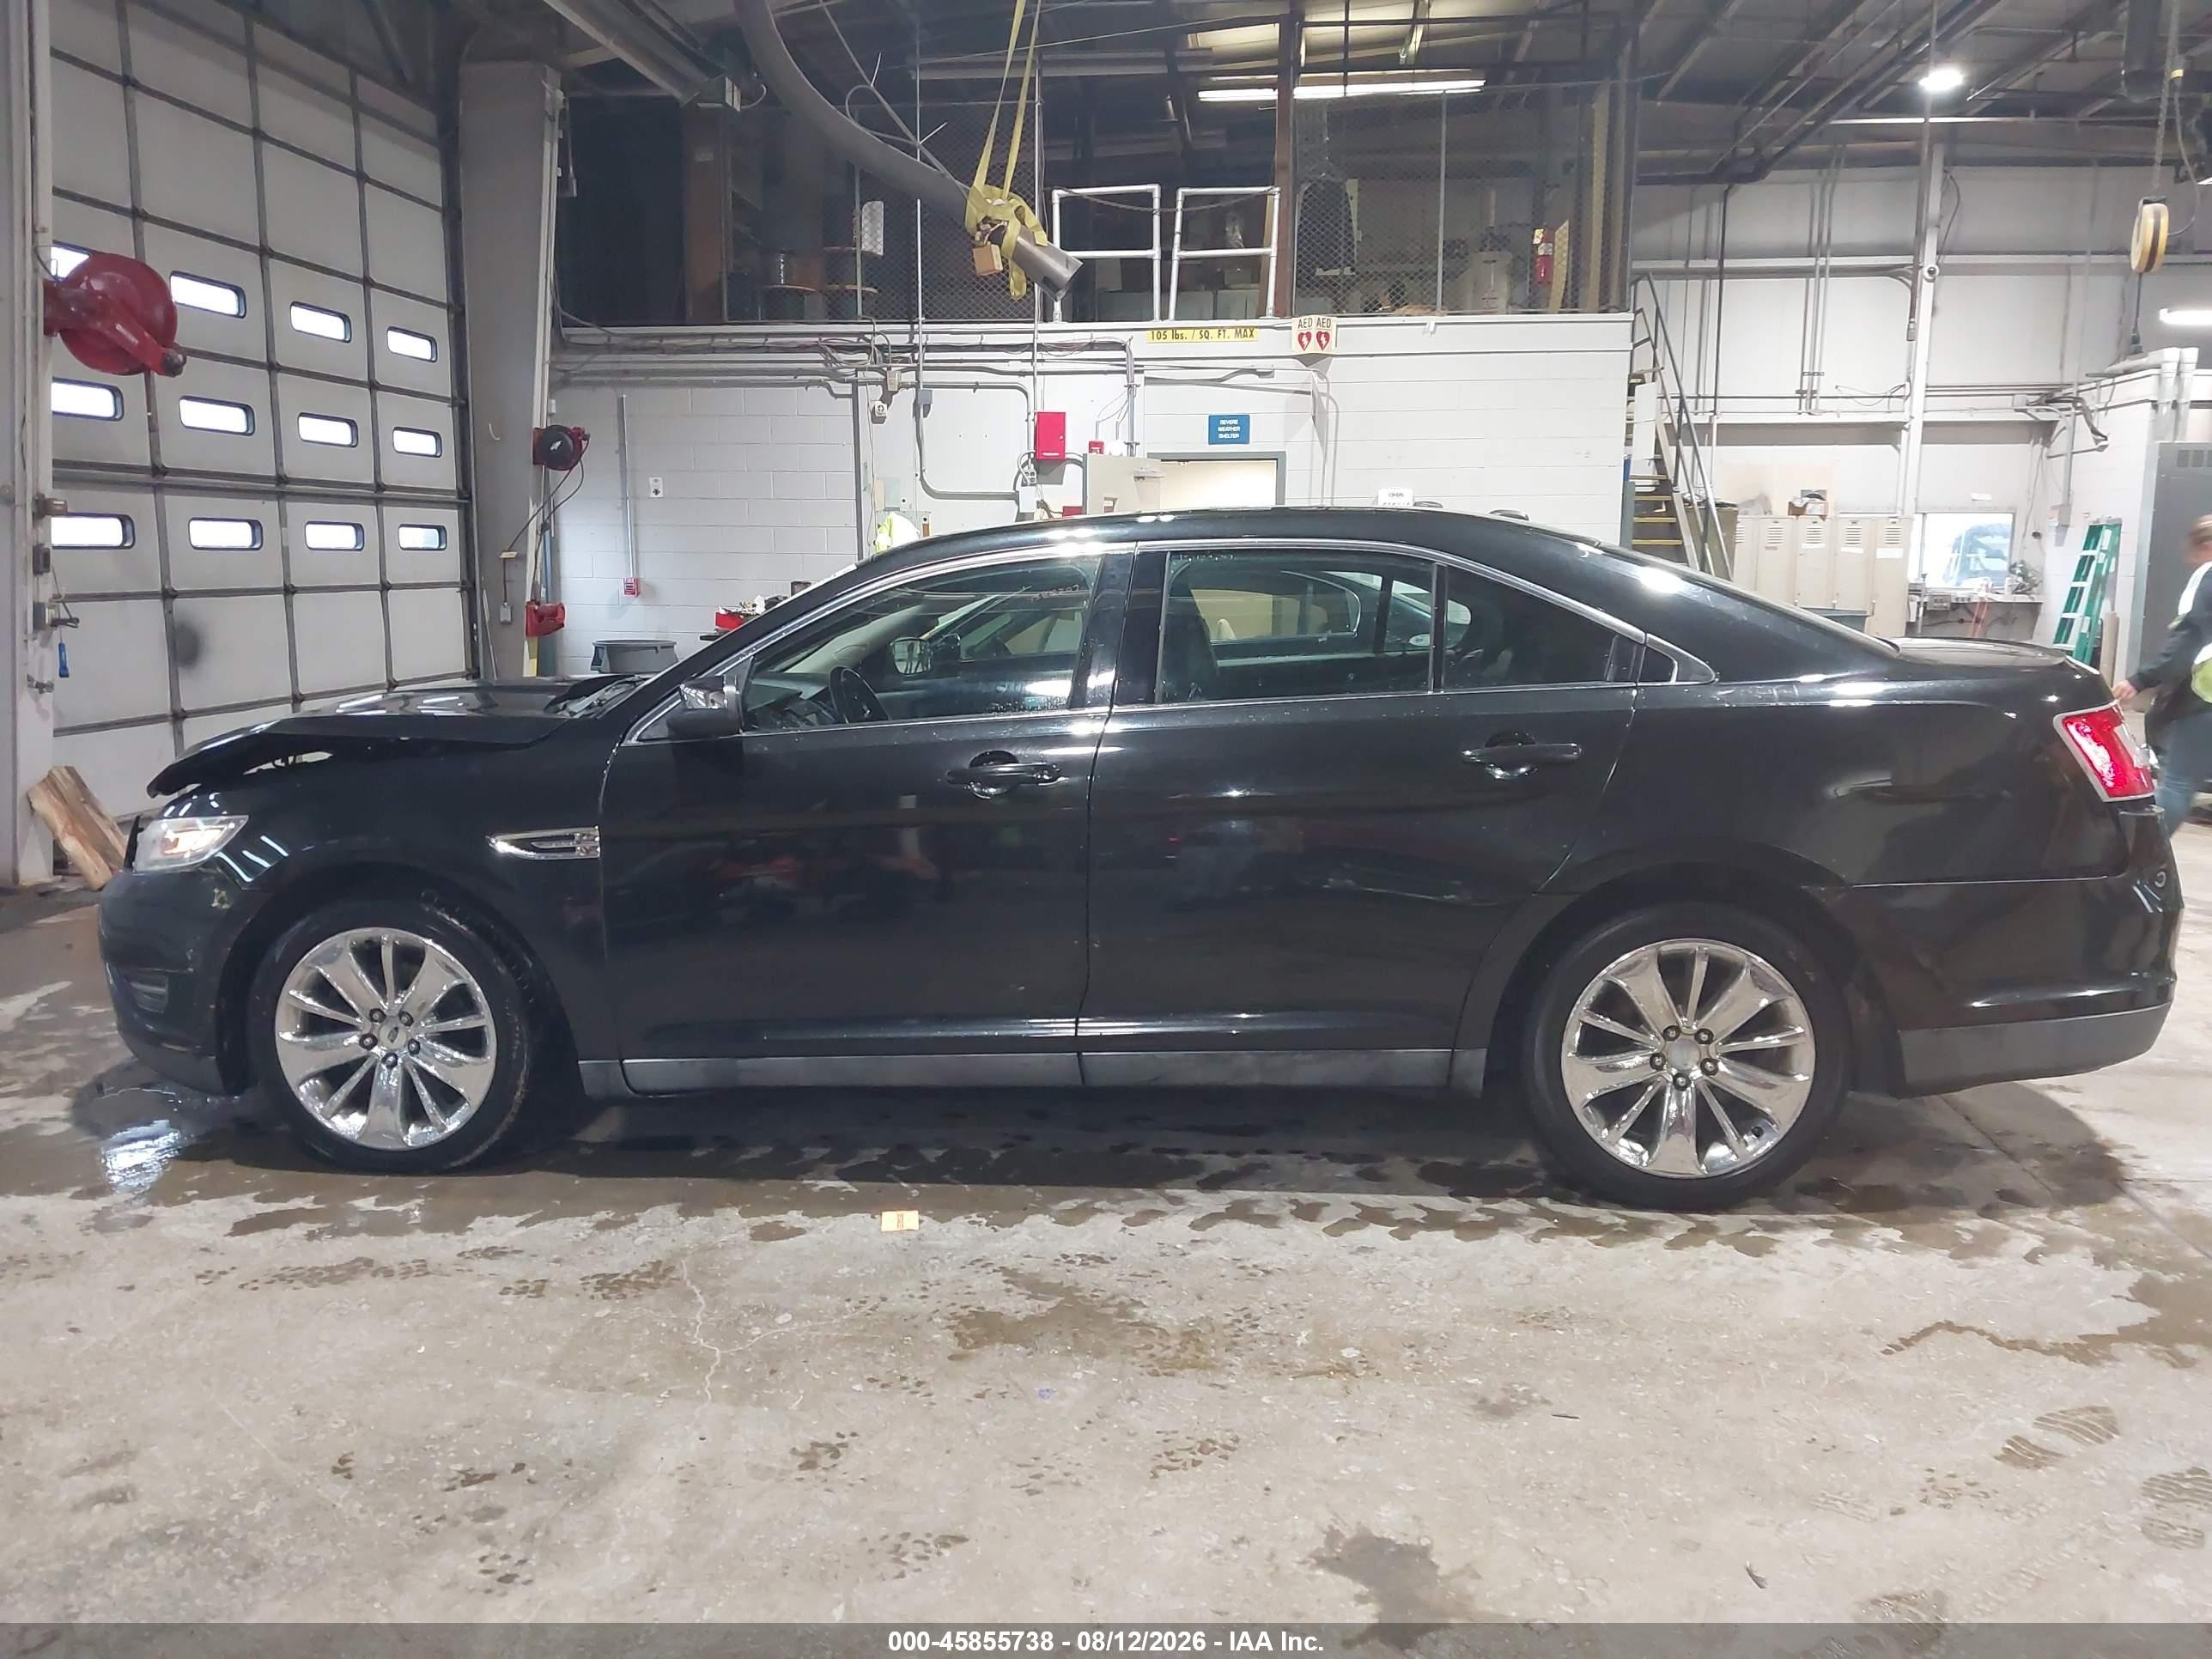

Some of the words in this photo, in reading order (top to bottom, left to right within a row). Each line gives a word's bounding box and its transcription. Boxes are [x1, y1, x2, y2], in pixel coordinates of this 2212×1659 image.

[1298, 318, 1313, 328] AED
[1316, 317, 1331, 328] AED
[1152, 331, 1168, 340] 105
[1171, 329, 1188, 340] lbs.
[1200, 330, 1213, 340] SQ.
[1218, 329, 1231, 339] FT.
[1235, 327, 1255, 338] MAX
